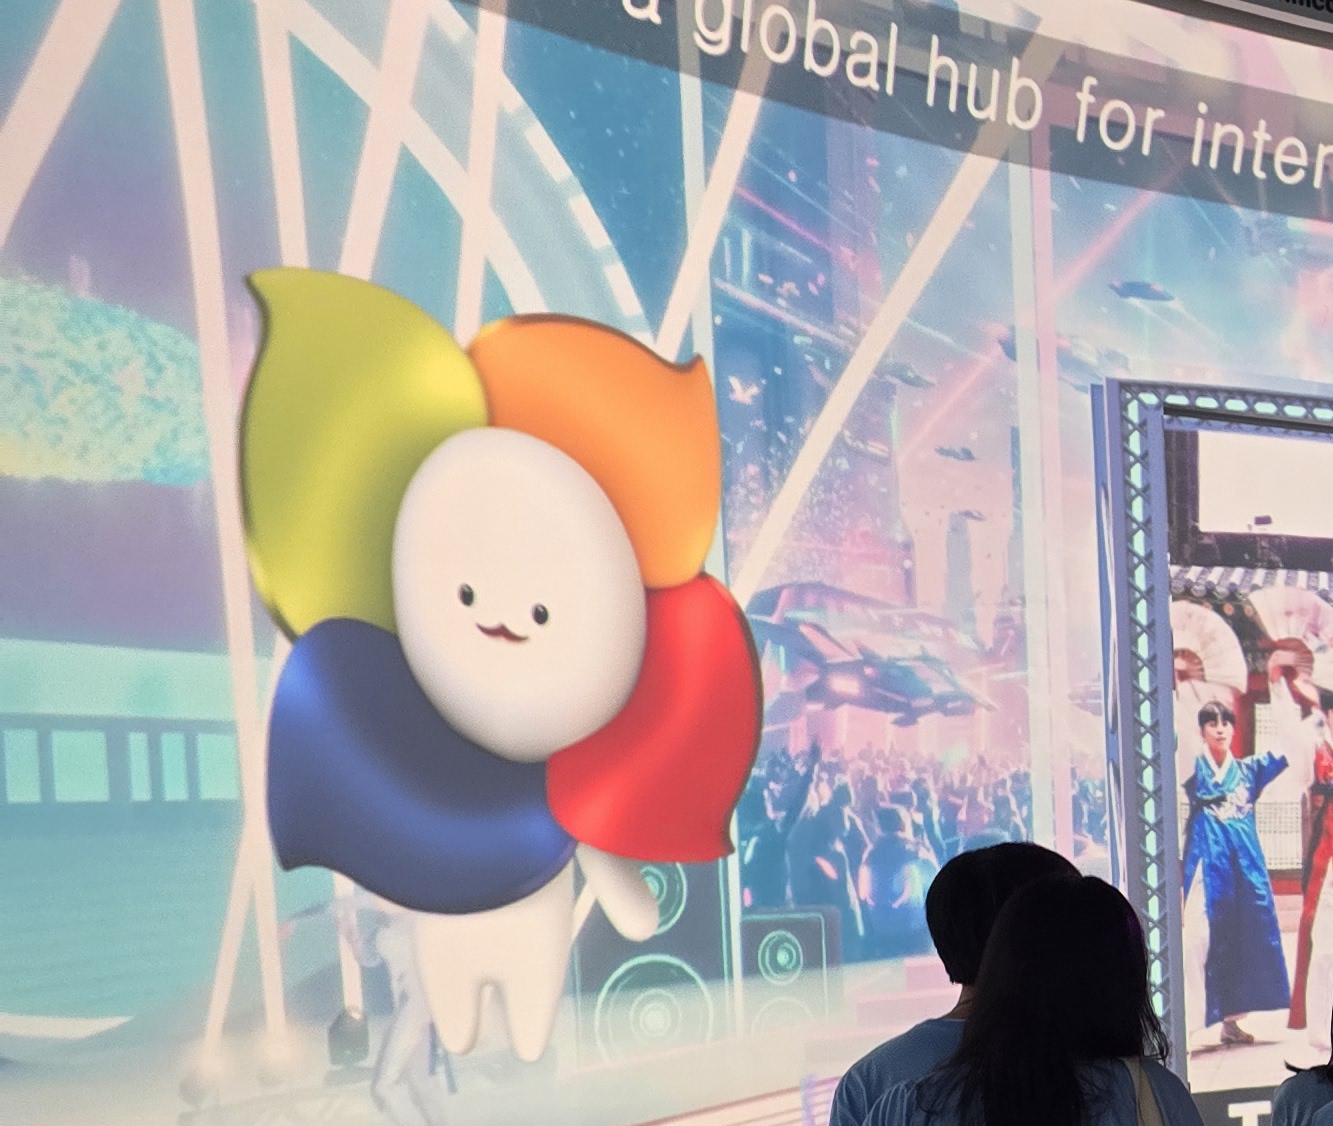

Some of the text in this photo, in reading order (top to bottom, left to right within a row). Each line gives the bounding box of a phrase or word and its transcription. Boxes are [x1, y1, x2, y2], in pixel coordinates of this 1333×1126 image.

[693, 0, 898, 96] global
[926, 34, 1044, 132] hub
[1075, 76, 1165, 157] for
